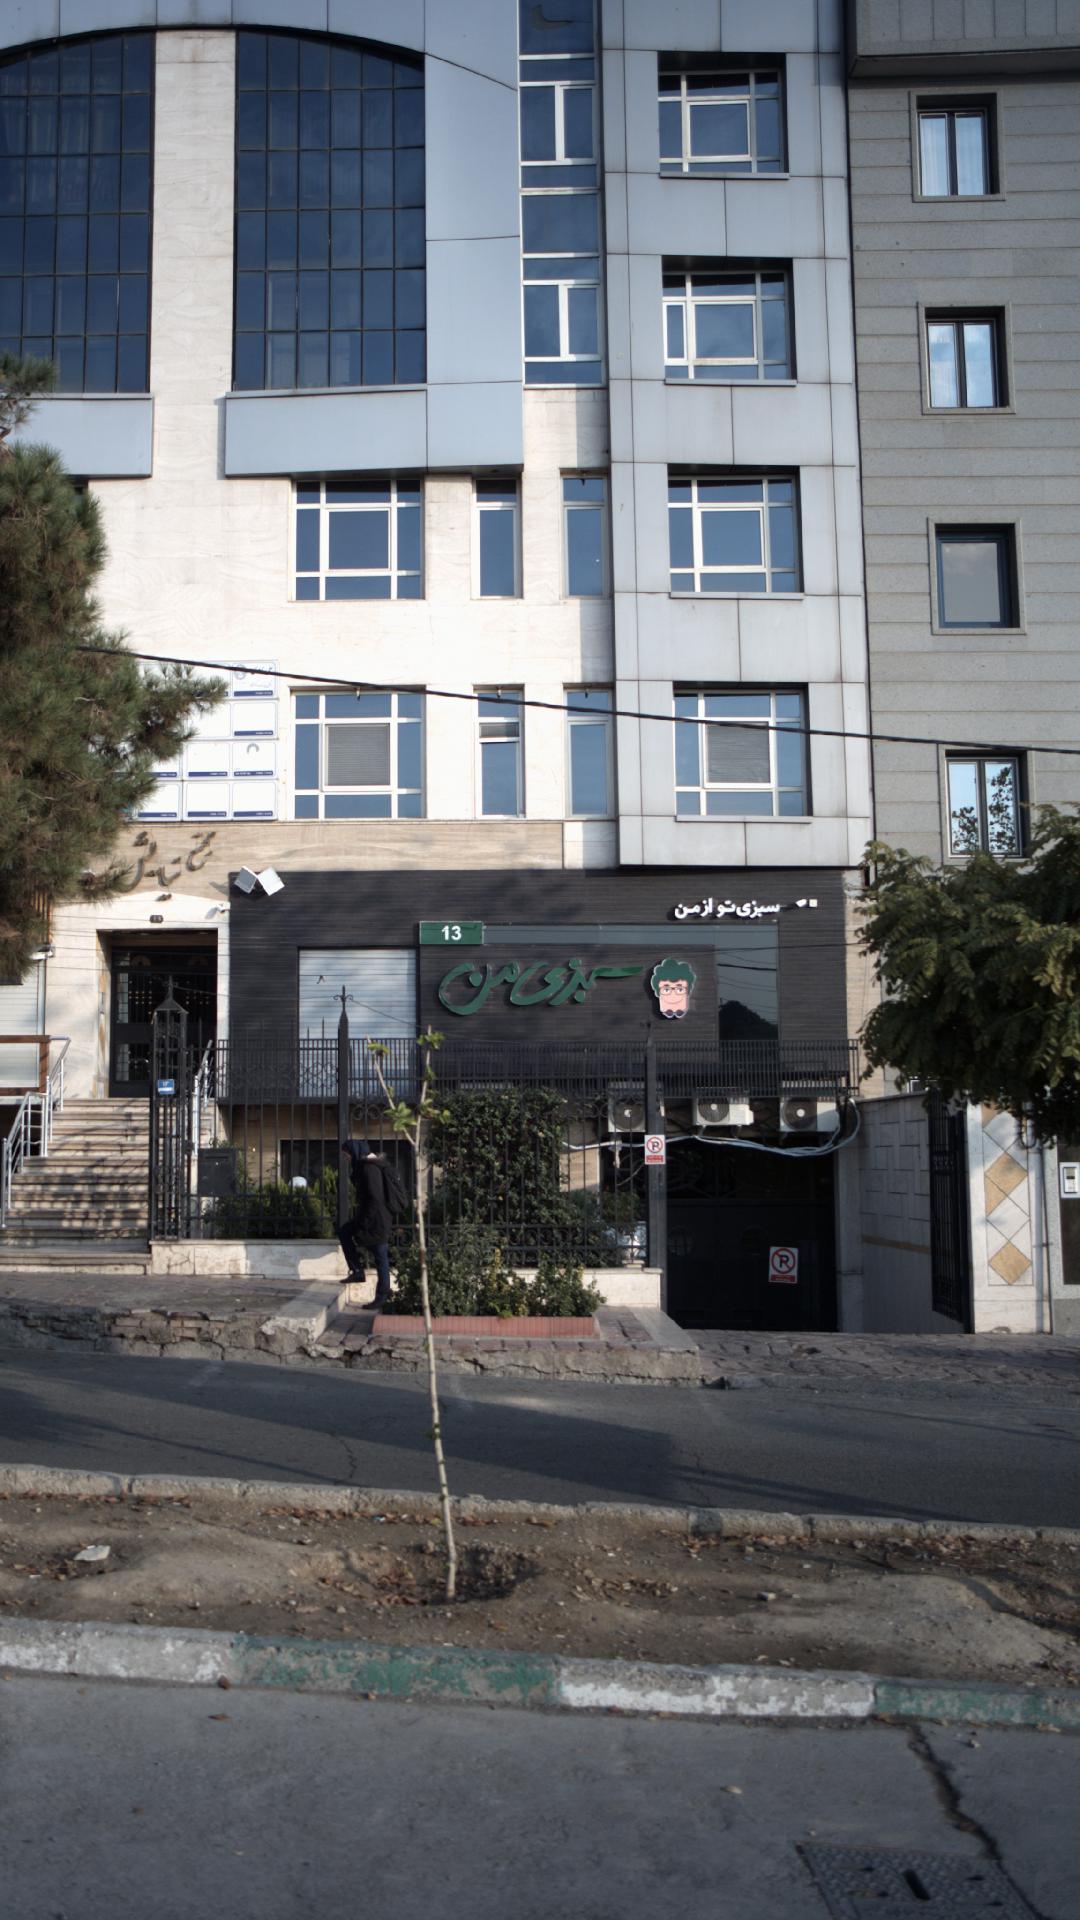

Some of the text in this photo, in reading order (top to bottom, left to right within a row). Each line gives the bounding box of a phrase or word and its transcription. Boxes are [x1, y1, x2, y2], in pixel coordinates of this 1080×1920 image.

[441, 925, 462, 940] 13
[438, 957, 645, 1016] سبزی من
